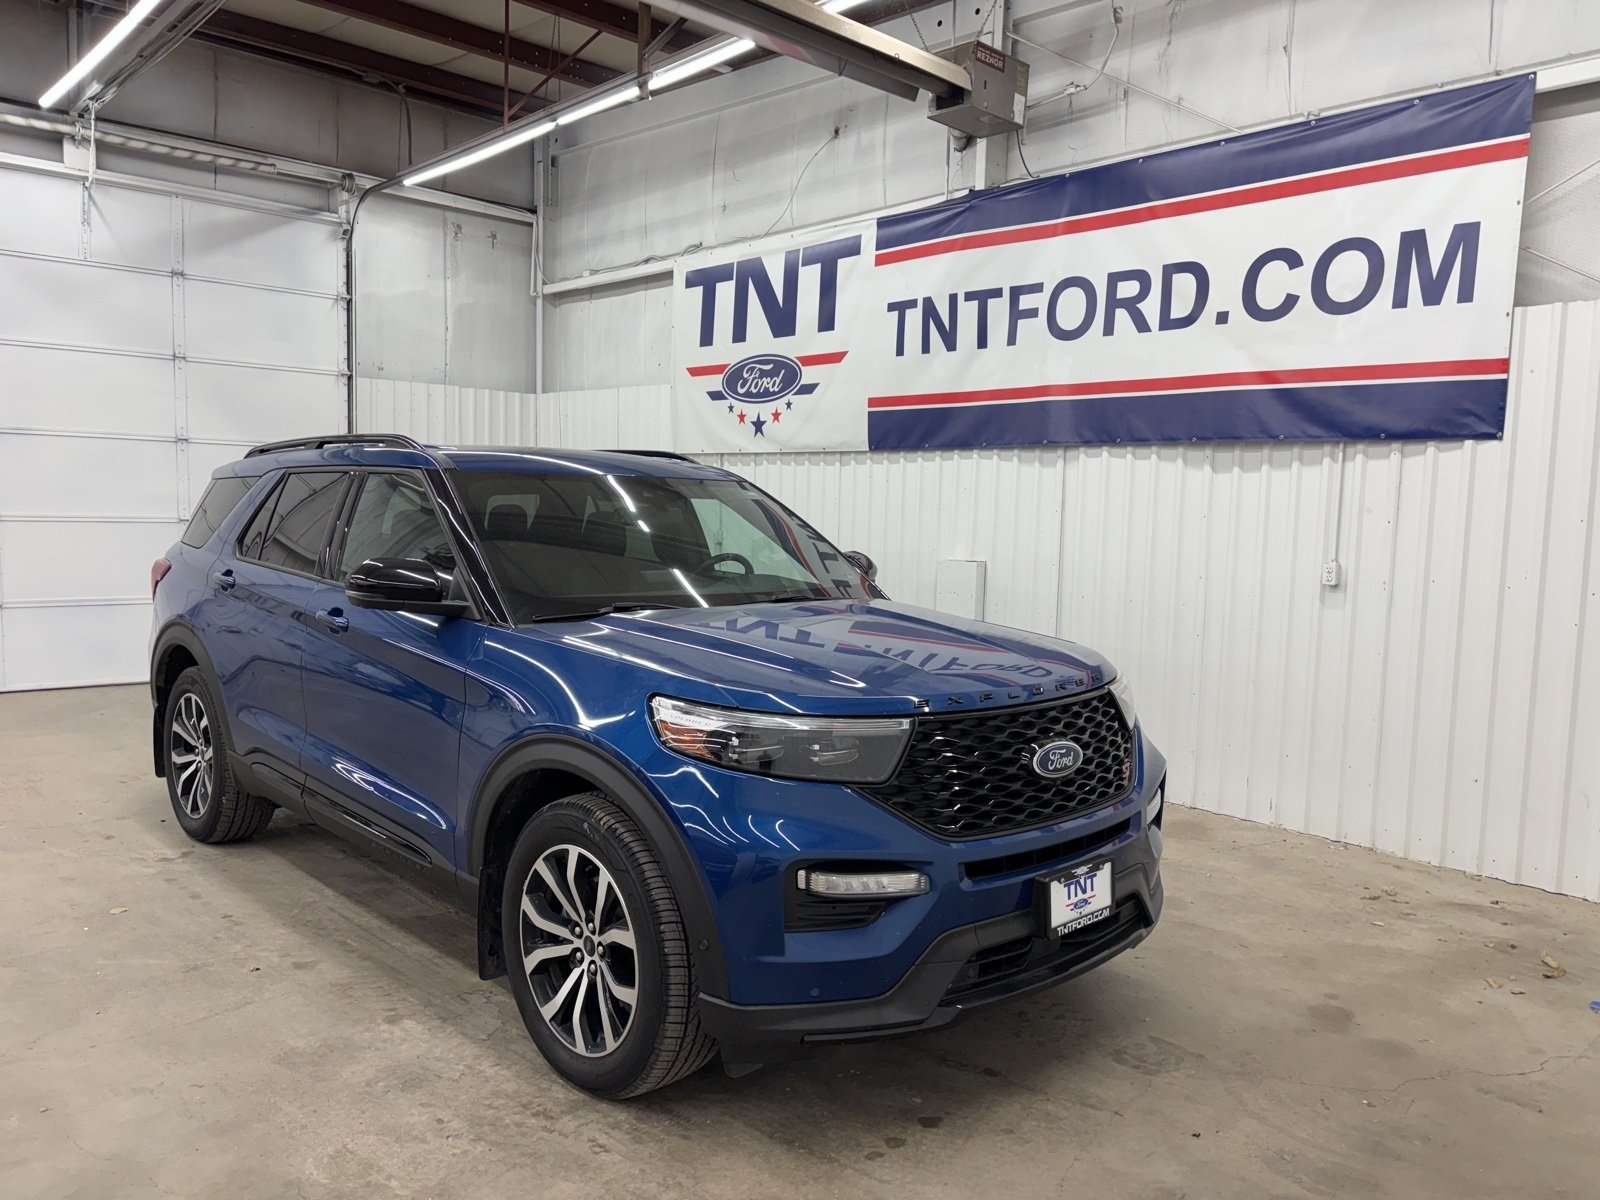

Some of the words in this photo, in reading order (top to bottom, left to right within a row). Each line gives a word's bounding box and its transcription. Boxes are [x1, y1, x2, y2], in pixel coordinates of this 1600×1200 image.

[977, 50, 1004, 70] REZNOR
[685, 234, 862, 347] TNT
[887, 221, 1481, 357] TNTFORD.COM
[737, 363, 785, 394] Ford
[1048, 749, 1074, 770] Ford
[1064, 872, 1097, 900] TNT
[1057, 908, 1110, 936] TNTFORD.COM
